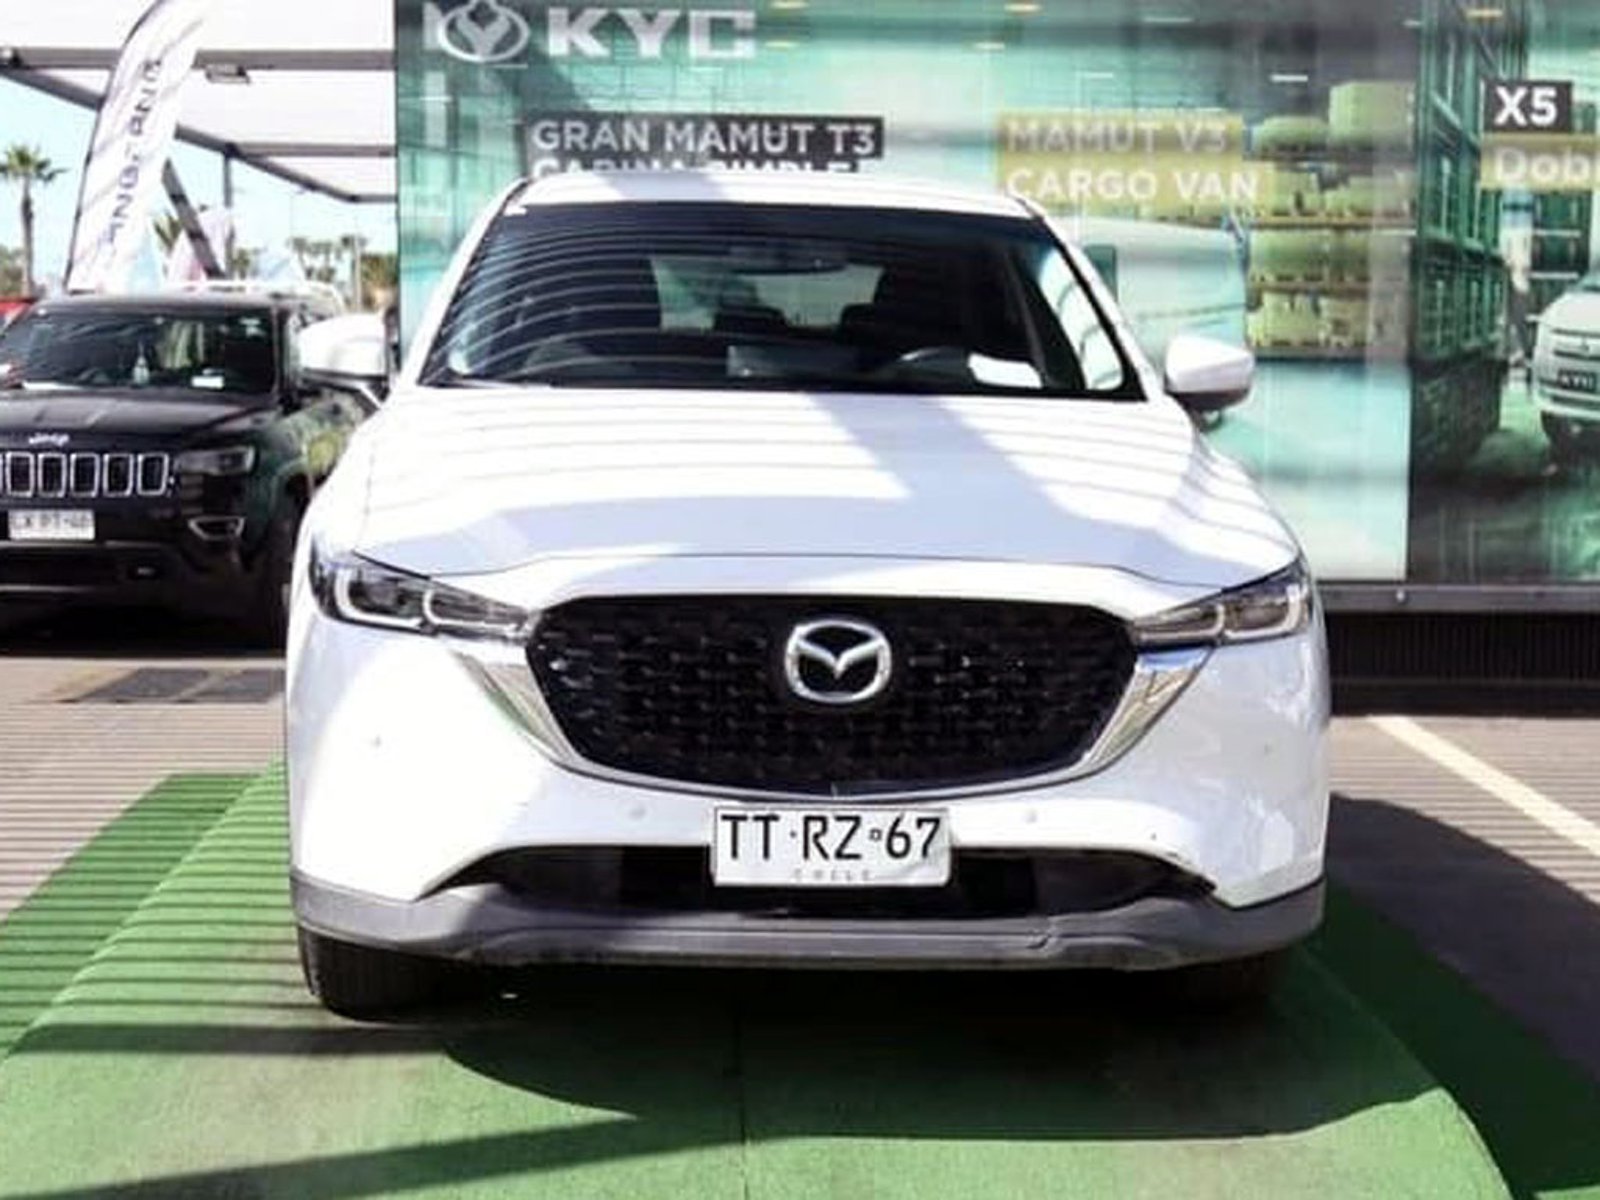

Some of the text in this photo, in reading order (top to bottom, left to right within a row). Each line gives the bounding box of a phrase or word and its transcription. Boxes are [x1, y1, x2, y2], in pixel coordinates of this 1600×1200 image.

[547, 7, 756, 58] KYC
[1493, 86, 1558, 127] X5
[531, 119, 876, 156] GRAN MAMUT T3
[1005, 119, 1228, 152] MAMUT V3
[1004, 168, 1262, 201] CARGO VAN
